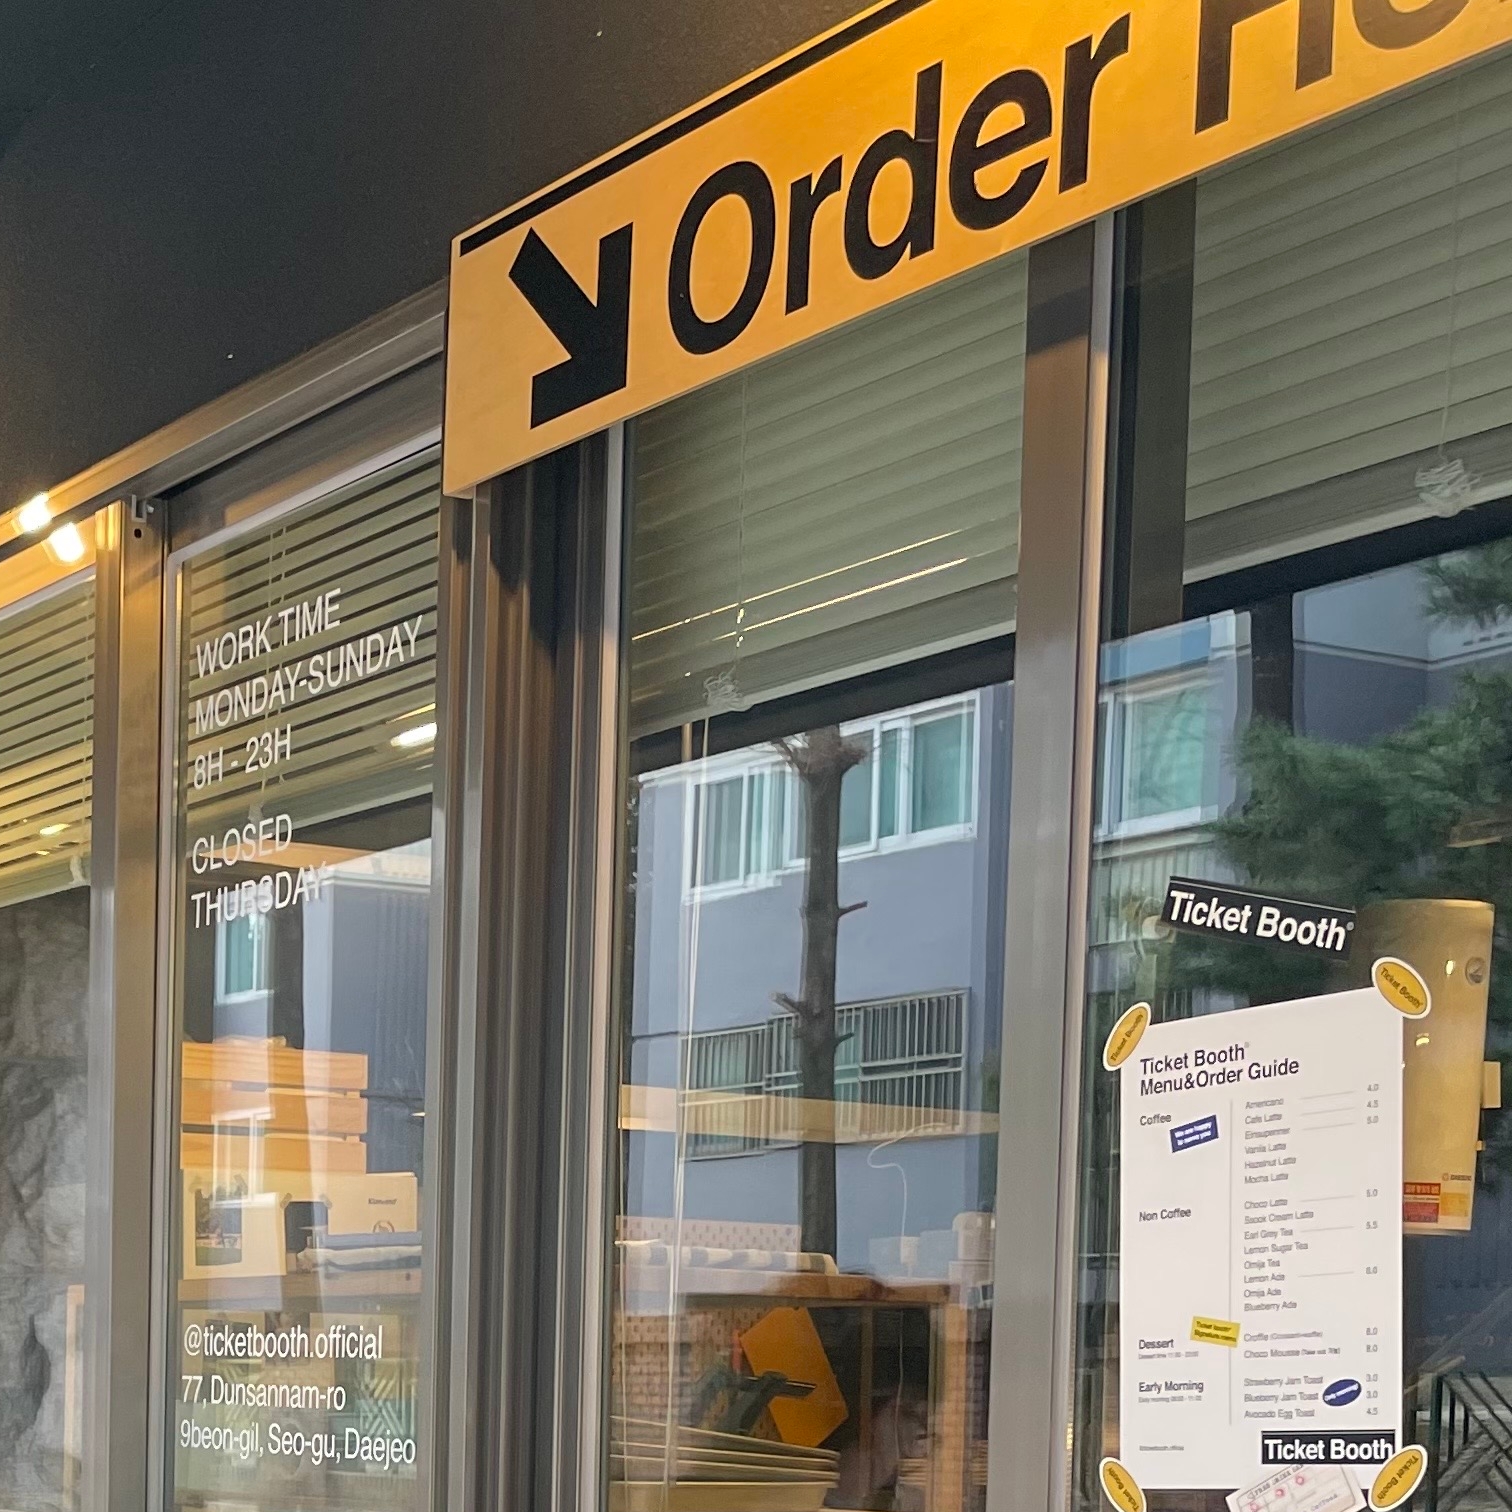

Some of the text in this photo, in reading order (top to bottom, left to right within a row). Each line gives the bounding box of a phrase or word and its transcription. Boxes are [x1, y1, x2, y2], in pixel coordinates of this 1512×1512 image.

[668, 13, 1130, 355] Order
[196, 588, 341, 678] WORK TIME
[195, 615, 423, 734] MONDAY-SUNDAY
[194, 747, 223, 789] 8H
[245, 724, 291, 773] 23H
[192, 814, 292, 875] CLOSED
[191, 861, 328, 929] THURSDAY
[1170, 890, 1346, 951] Ticket Booth
[1140, 1044, 1245, 1075] Ticket Booth
[1140, 1057, 1300, 1096] Menu&Order Guide
[1139, 1113, 1172, 1126] Coffee
[1264, 1113, 1283, 1123] Latte
[1268, 1143, 1287, 1152] Latte
[1278, 1157, 1297, 1166] Latte
[1139, 1208, 1192, 1222] Non Coffee
[1280, 1228, 1293, 1236] Tea
[1244, 1246, 1269, 1255] Lemon
[1294, 1241, 1309, 1250] Tea
[1244, 1275, 1269, 1284] Lemon
[183, 1324, 383, 1360] @ticketbooth.official
[1138, 1339, 1175, 1350] Dessert
[181, 1374, 346, 1411] 77, Dunsannam-ro
[1139, 1380, 1204, 1394] Early Morning
[1278, 1409, 1293, 1419] Egg
[180, 1419, 416, 1471] 9beon-gil, Seo-gu, Daejeo
[1264, 1438, 1394, 1460] Ticket Booth
